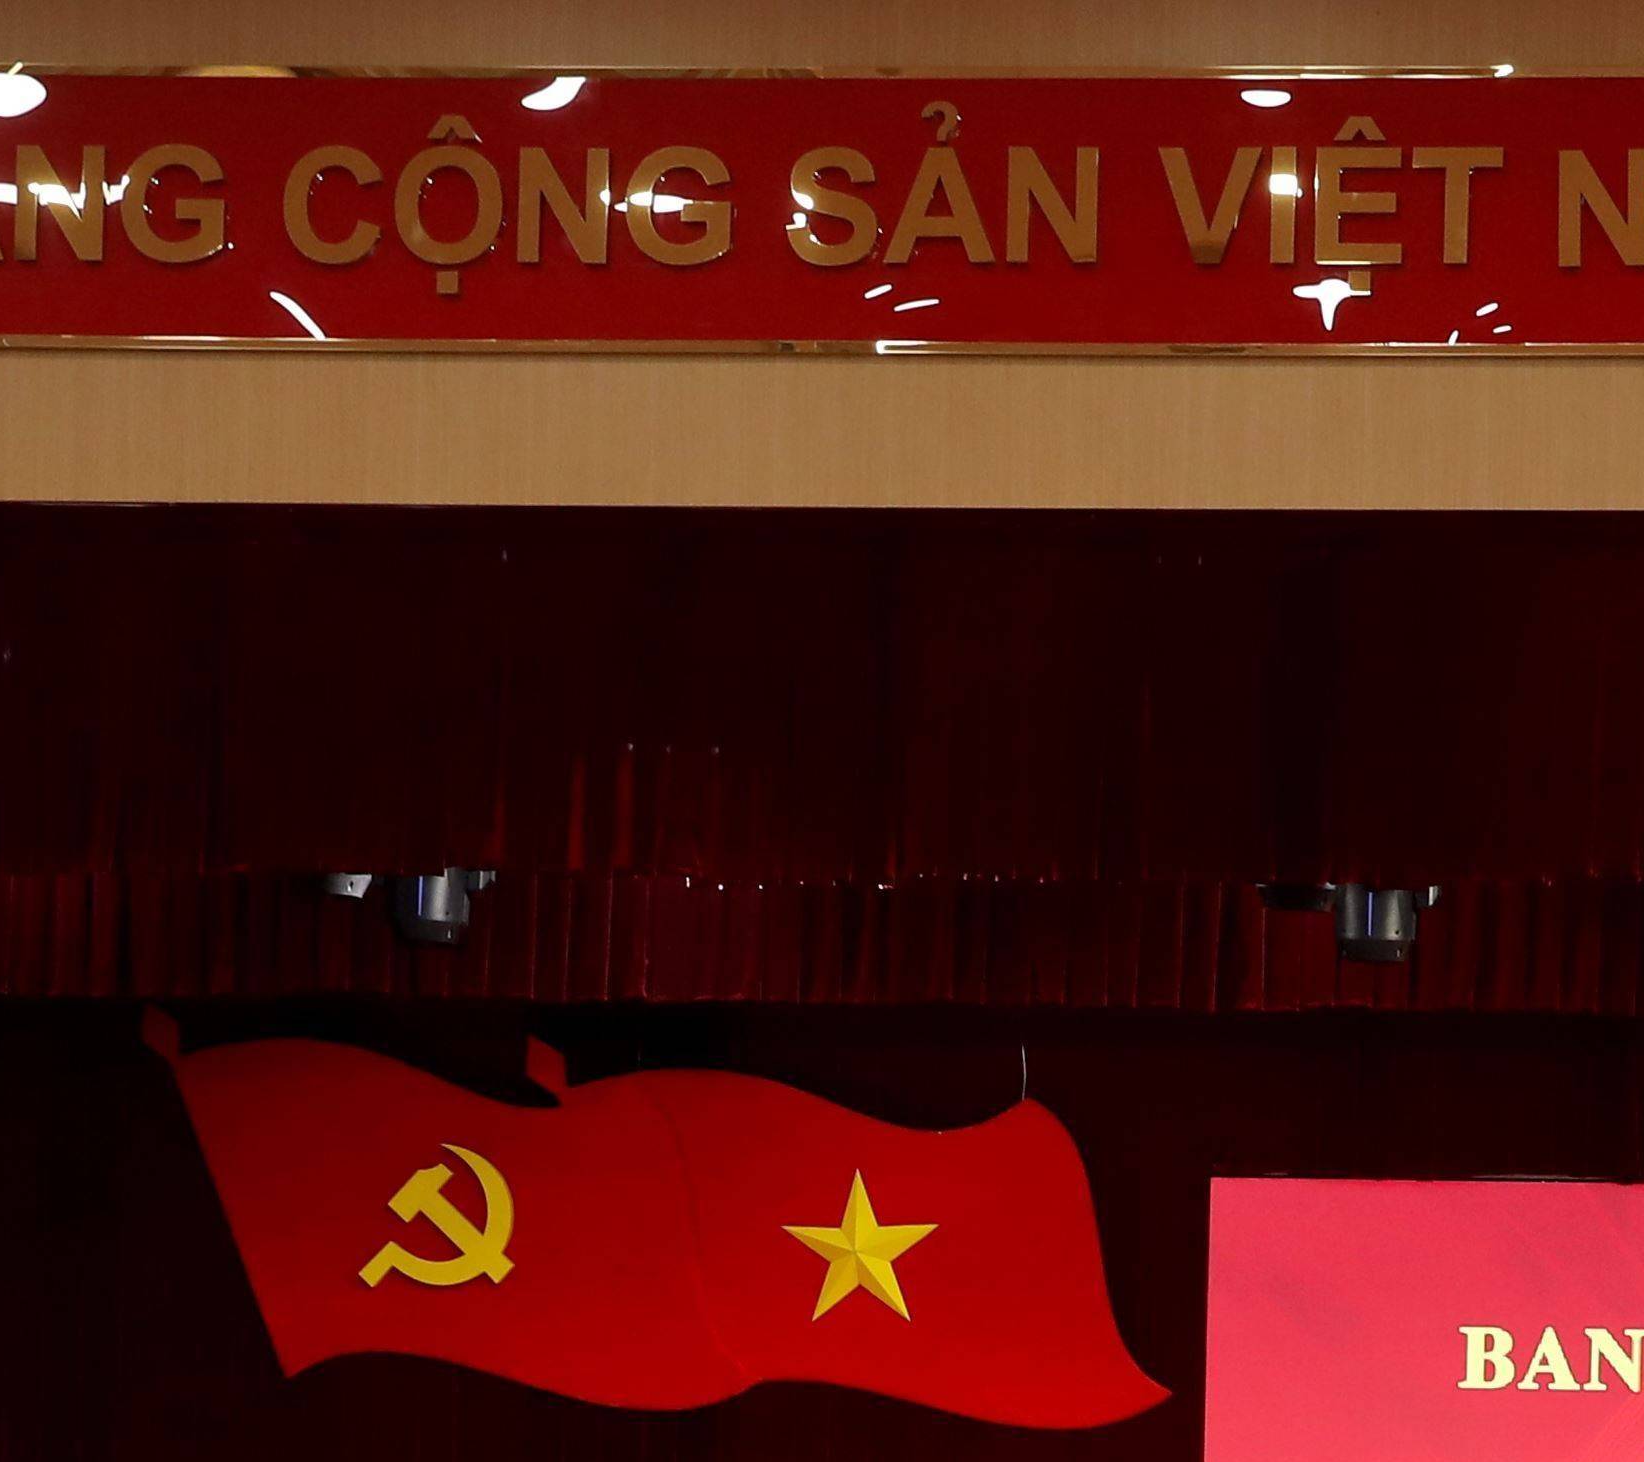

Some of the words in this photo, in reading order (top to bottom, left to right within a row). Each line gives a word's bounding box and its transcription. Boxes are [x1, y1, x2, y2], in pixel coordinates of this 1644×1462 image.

[283, 114, 731, 293] CỘNG
[786, 100, 1099, 266] SẢN
[1158, 116, 1504, 292] VIỆT
